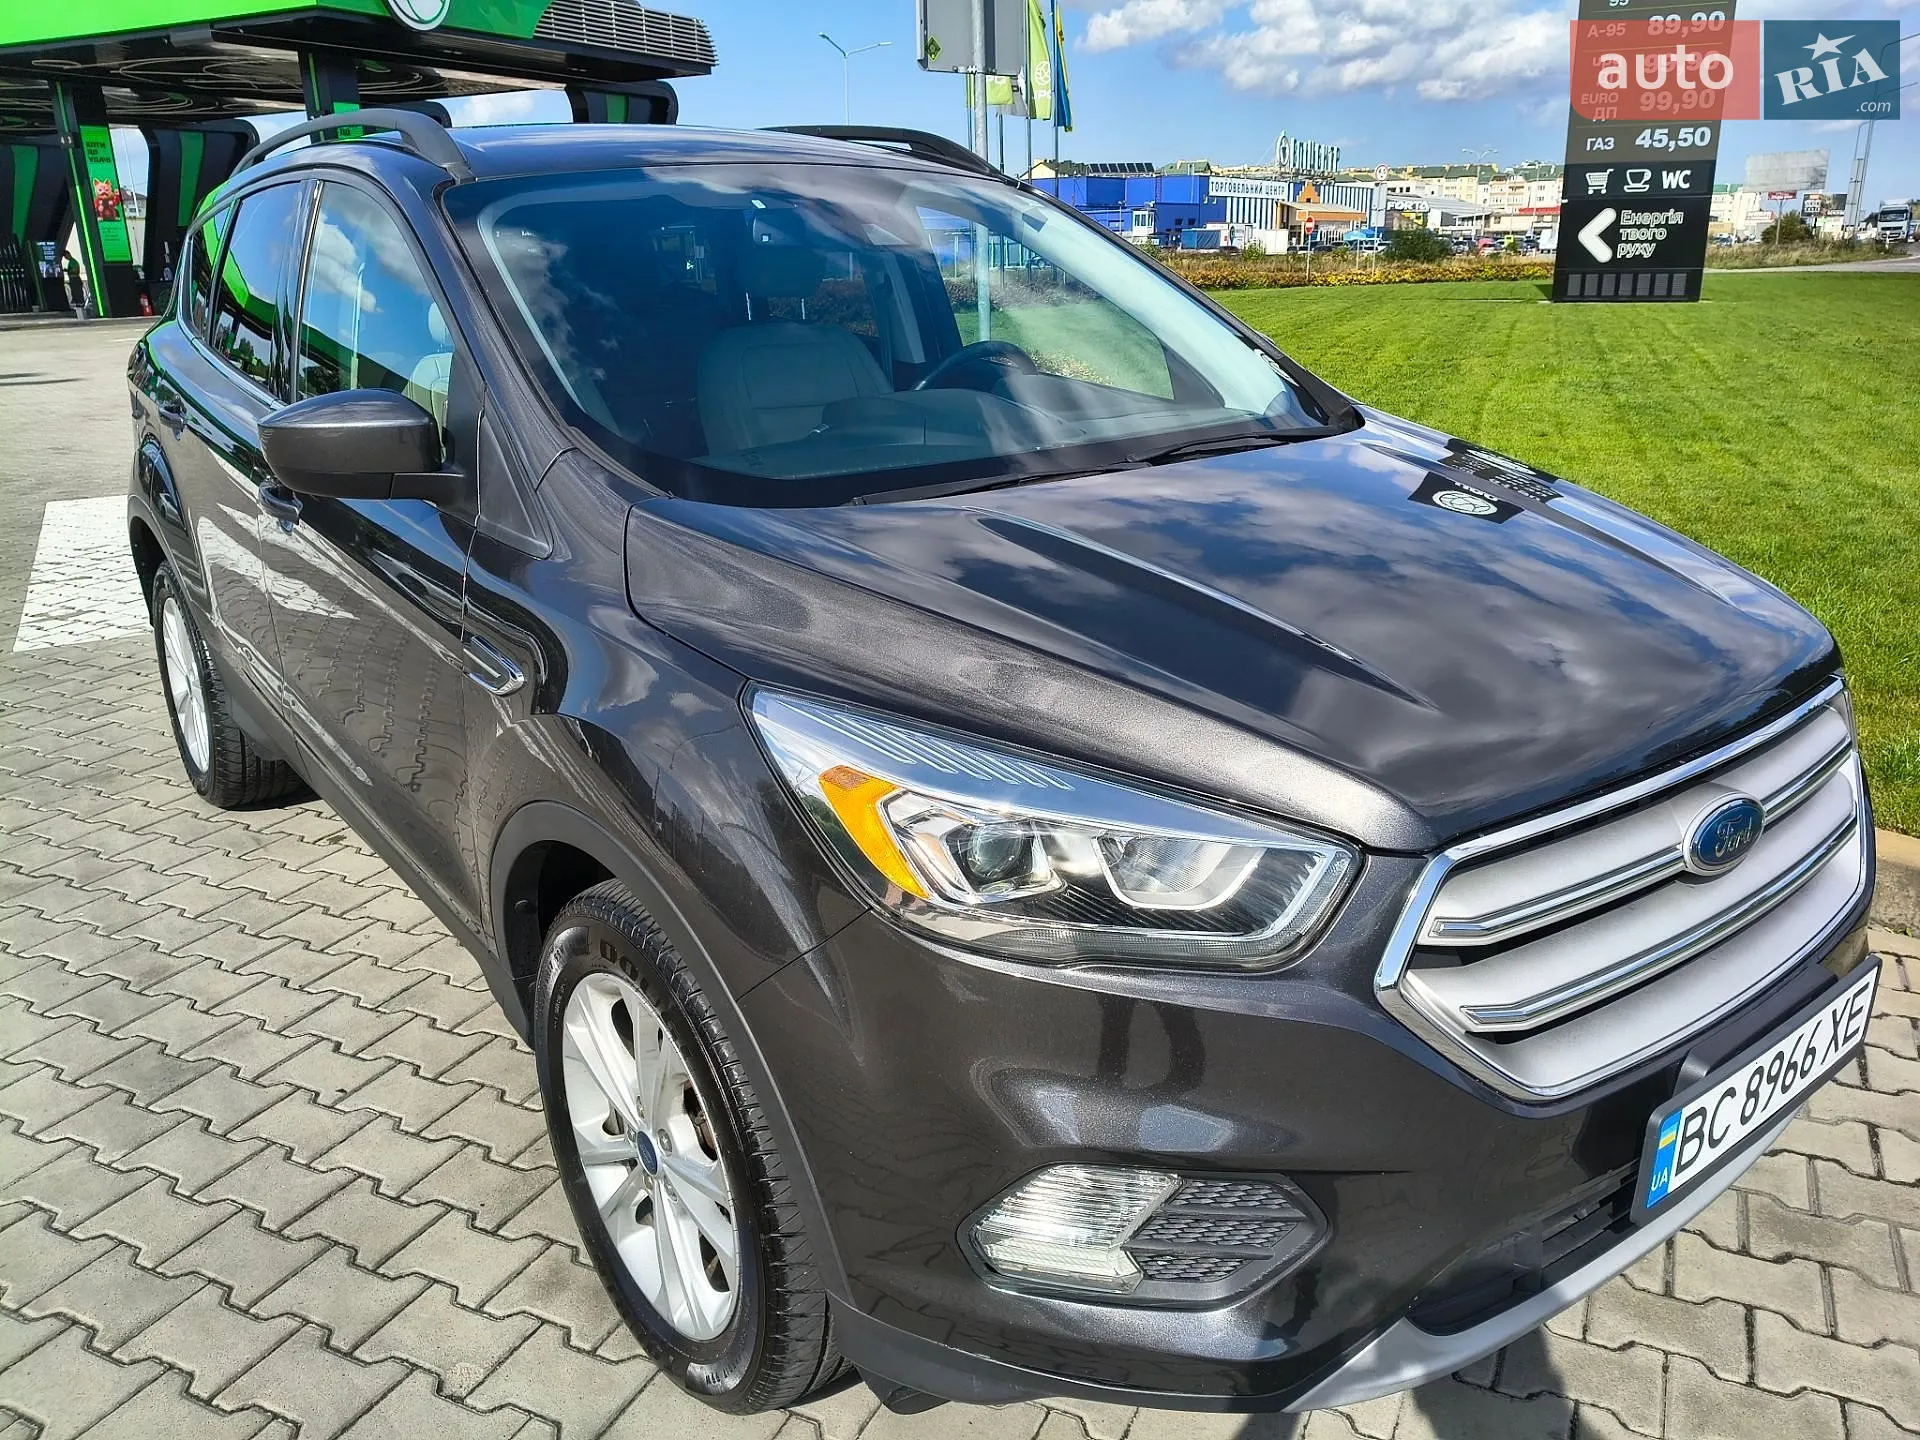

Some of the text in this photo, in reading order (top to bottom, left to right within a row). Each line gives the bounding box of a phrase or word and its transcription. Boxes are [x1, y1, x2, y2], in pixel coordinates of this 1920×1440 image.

[1647, 11, 1726, 38] 89,90
[1581, 89, 1716, 115] EURO 99,90
[1593, 106, 1618, 122] ДП
[1586, 127, 1712, 152] ГАЗ 45,50
[1211, 181, 1285, 196] ТОРГОВЕЛЬНИЙ ЦЕНТР
[1662, 170, 1691, 189] WC
[1387, 200, 1430, 212] FORTA
[1620, 209, 1684, 227] Енергія
[1619, 228, 1667, 241] твого
[1617, 243, 1656, 258] руху
[1715, 815, 1752, 858] Ford
[1675, 981, 1870, 1177] BC 8966 XE
[1651, 1173, 1669, 1192] UA
